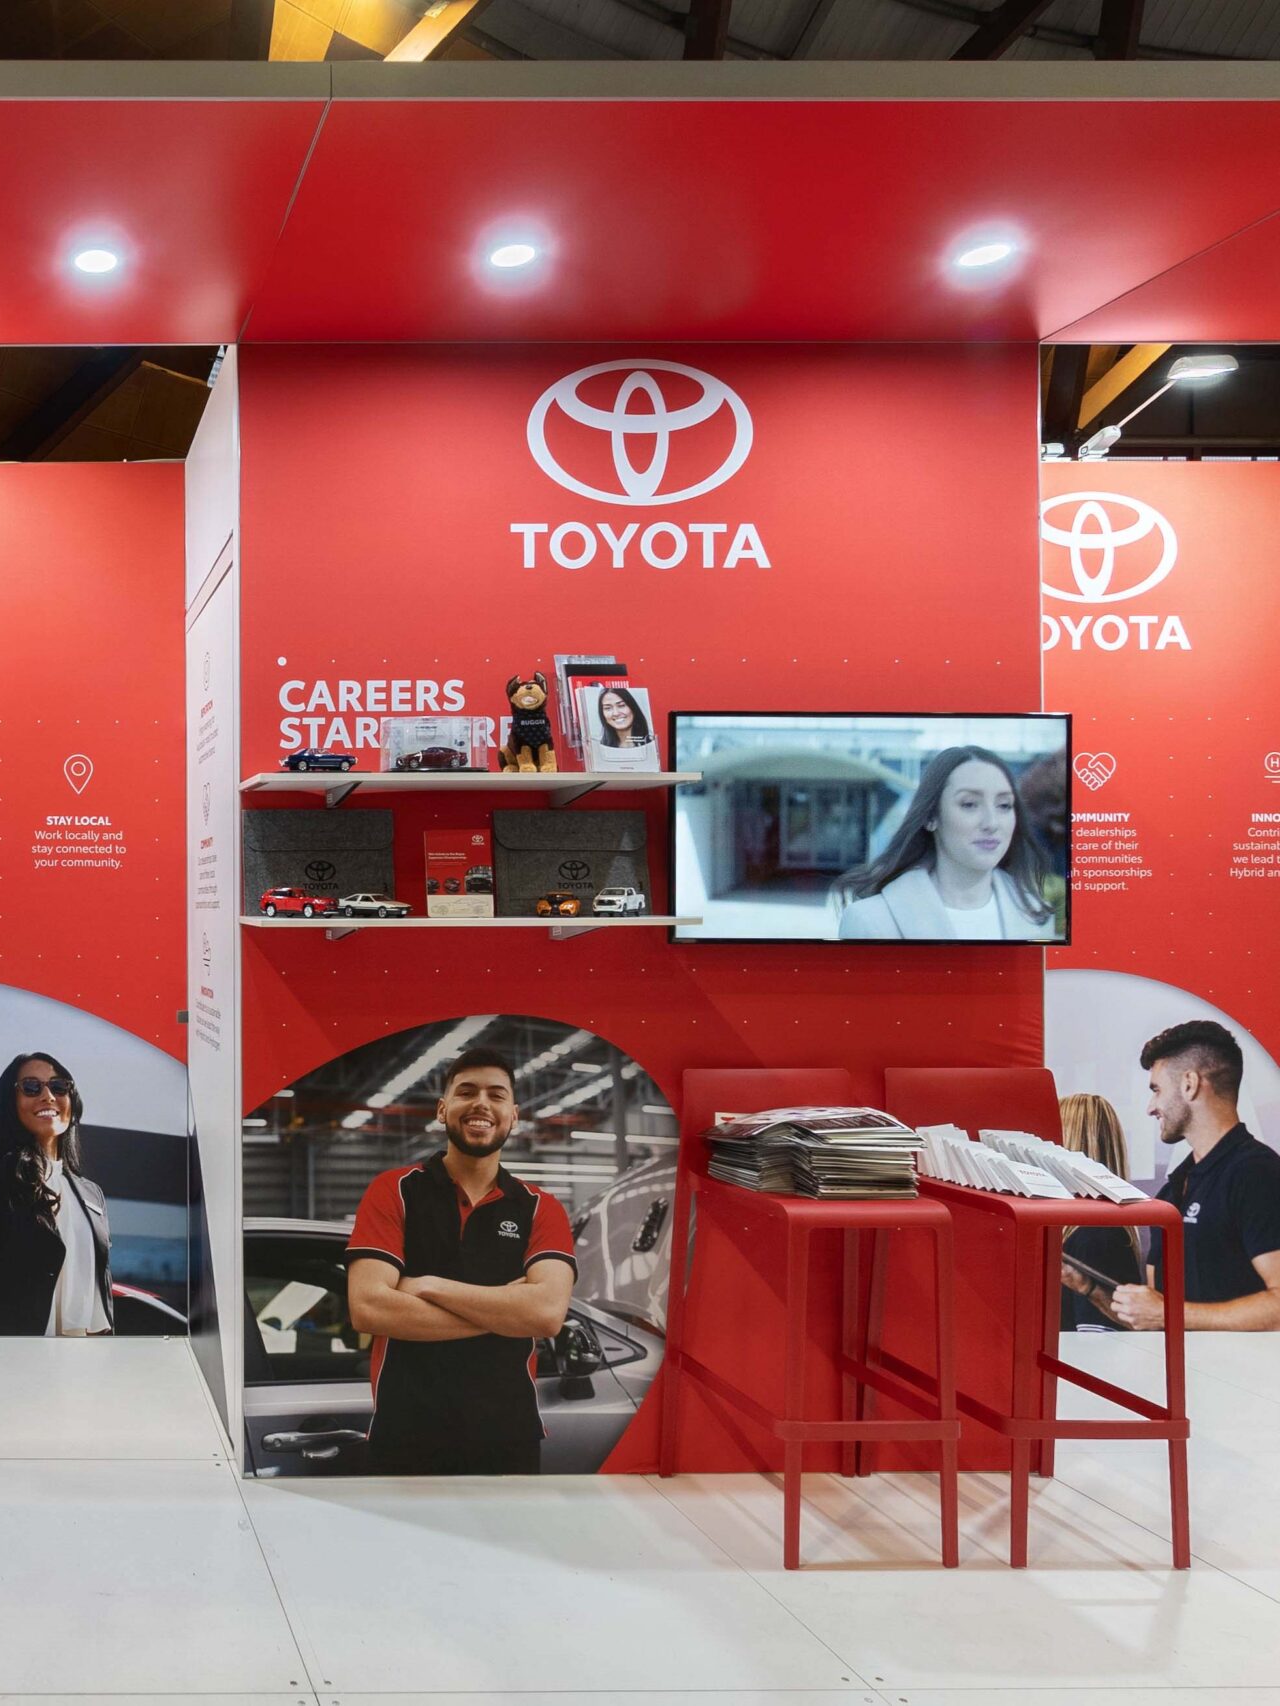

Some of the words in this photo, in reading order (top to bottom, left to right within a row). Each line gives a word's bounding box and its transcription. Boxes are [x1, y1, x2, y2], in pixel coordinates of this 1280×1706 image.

[510, 522, 771, 569] TOYOTA
[1041, 614, 1192, 650] OYOTA
[279, 679, 465, 713] CAREERS
[279, 716, 388, 749] STAR
[47, 816, 72, 825] STAY
[75, 816, 111, 825] LOCAL
[35, 831, 62, 840] Work
[65, 831, 99, 842] locally
[102, 831, 123, 840] and
[1076, 828, 1136, 838] dealerships
[32, 845, 53, 855] stay
[56, 845, 112, 853] connected
[116, 845, 126, 854] to
[1076, 842, 1098, 850] care
[1101, 841, 1112, 850] of
[1115, 841, 1139, 850] their
[35, 860, 58, 869] your
[61, 858, 122, 869] community.
[1076, 854, 1143, 863] communities
[1251, 854, 1273, 863] lead
[1083, 868, 1152, 878] sponsorships
[1230, 868, 1264, 879] Hybrid
[1084, 882, 1128, 892] support.
[498, 1230, 520, 1238] TOYOTA
